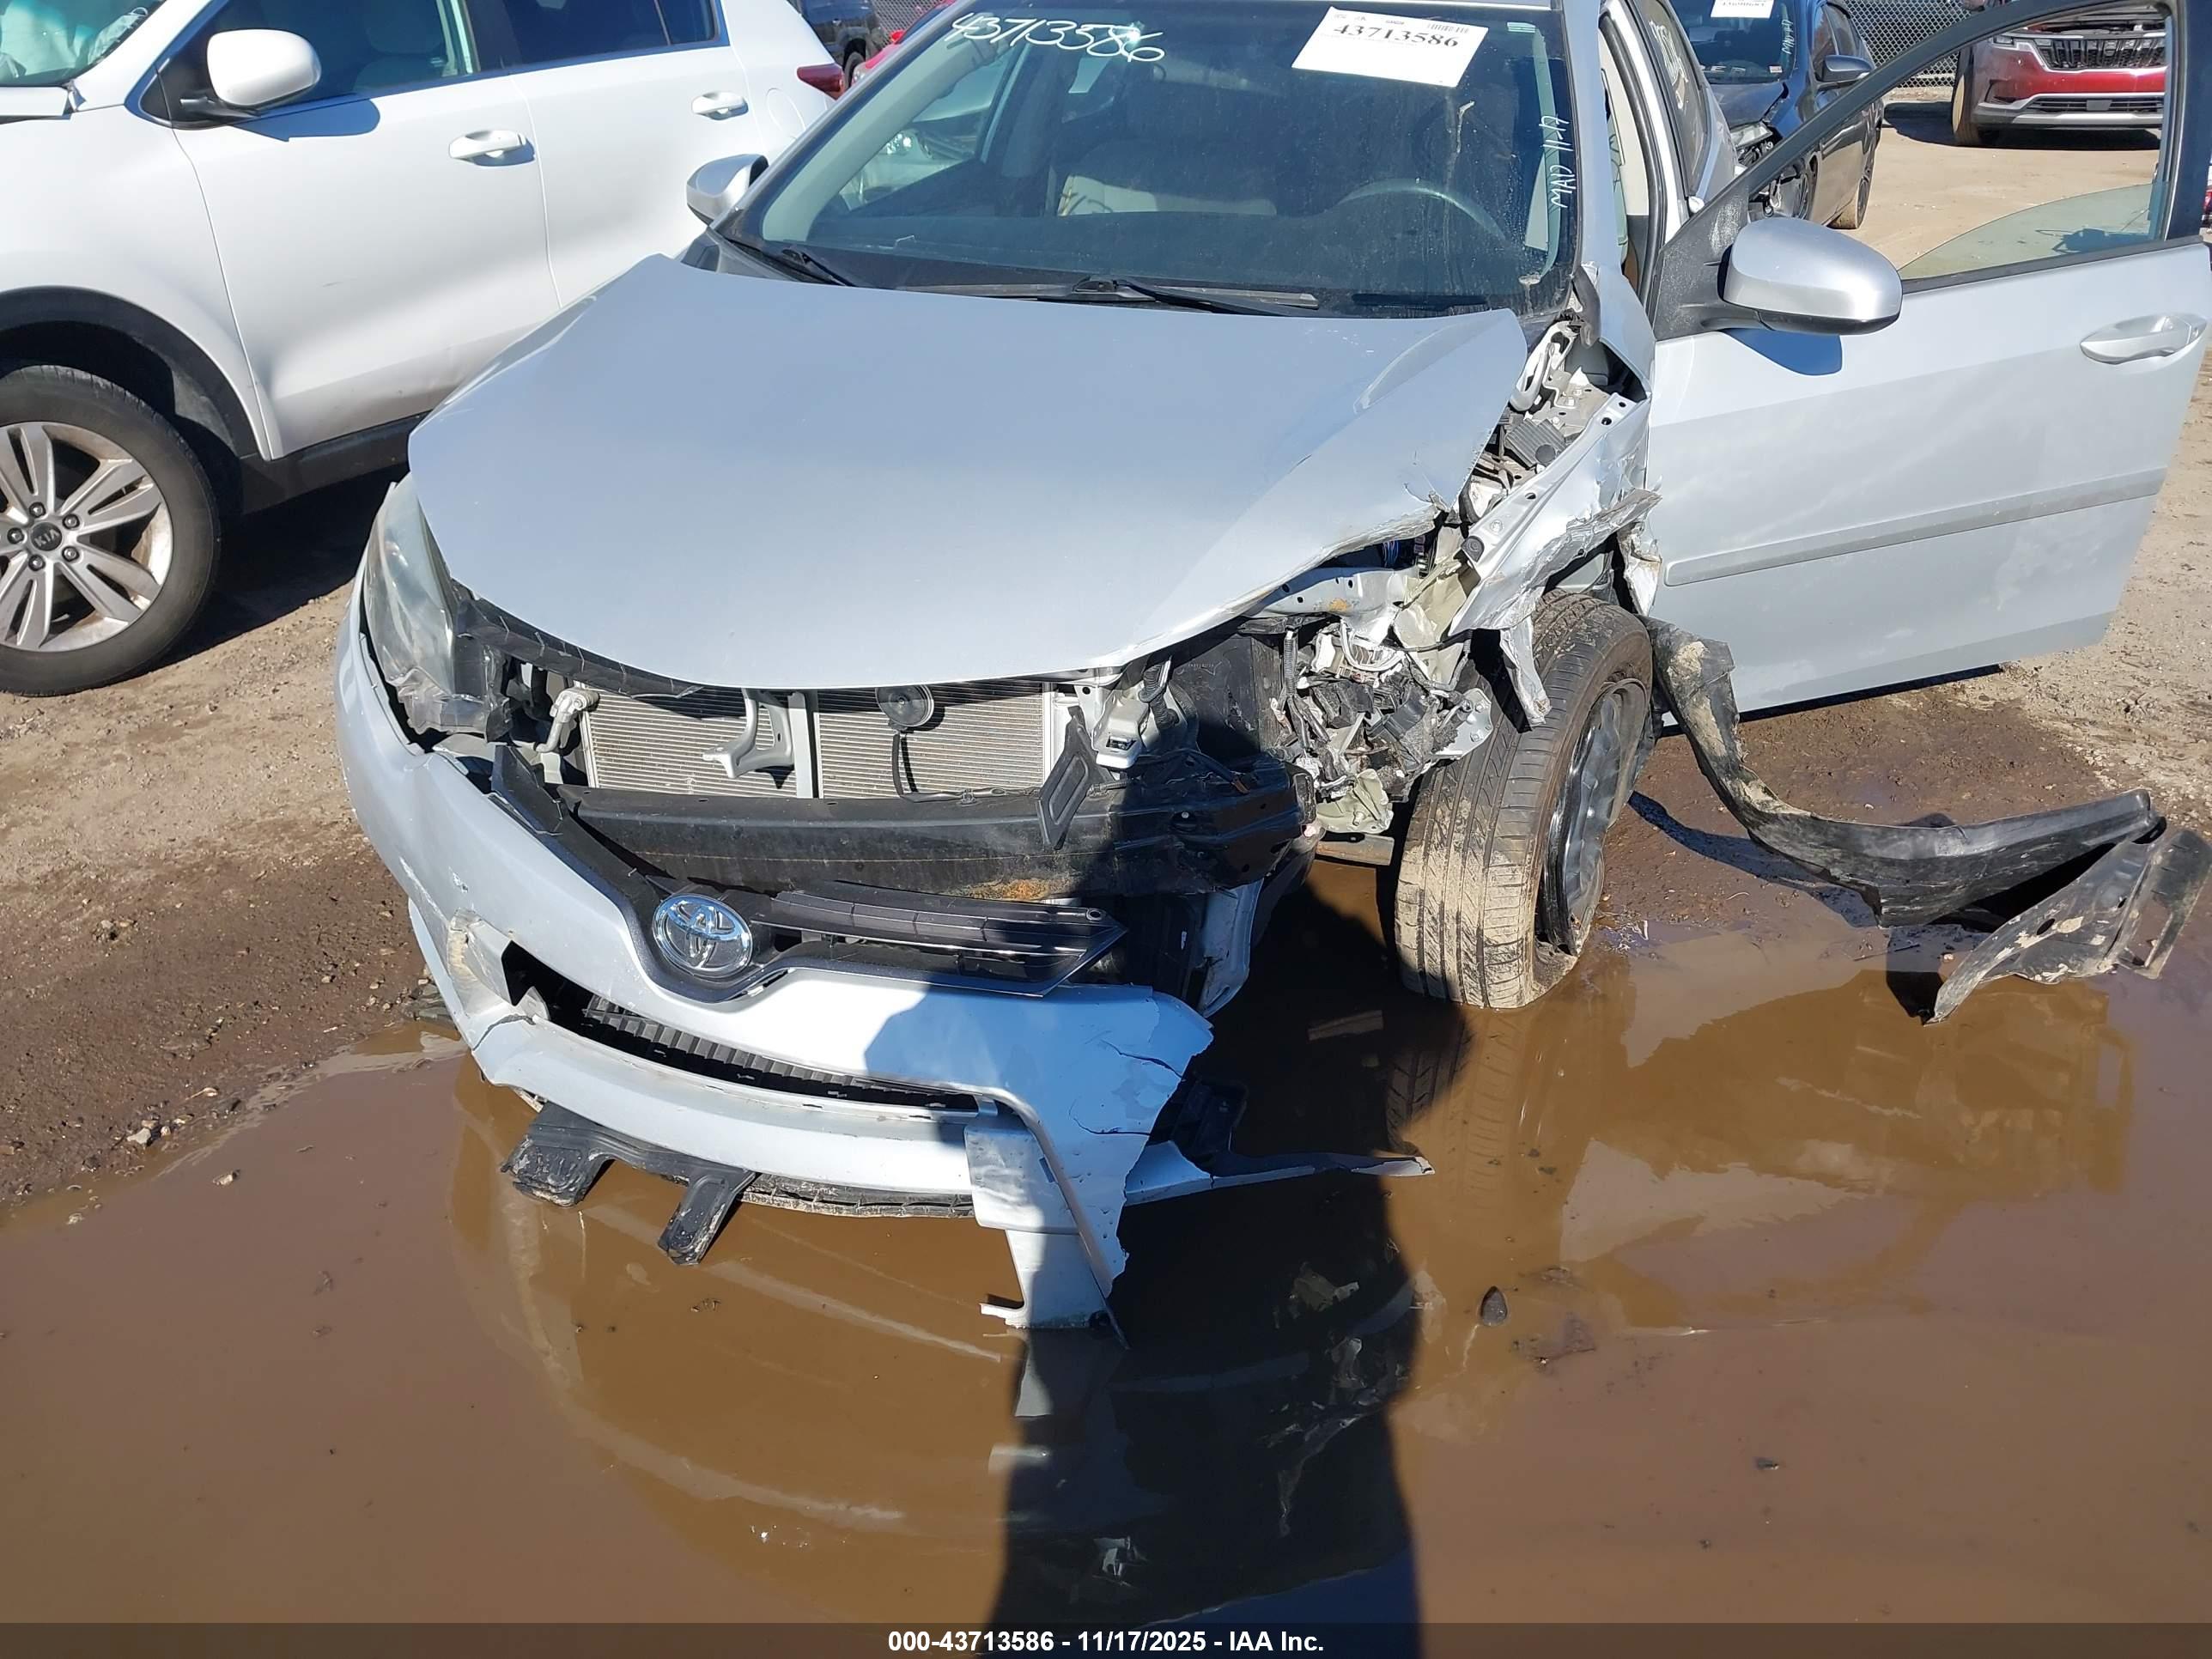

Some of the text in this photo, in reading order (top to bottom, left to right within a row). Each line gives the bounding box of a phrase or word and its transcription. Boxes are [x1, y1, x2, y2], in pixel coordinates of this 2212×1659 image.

[944, 12, 1165, 63] 43713586
[1333, 23, 1460, 47] 43713586
[33, 528, 60, 547] KIA
